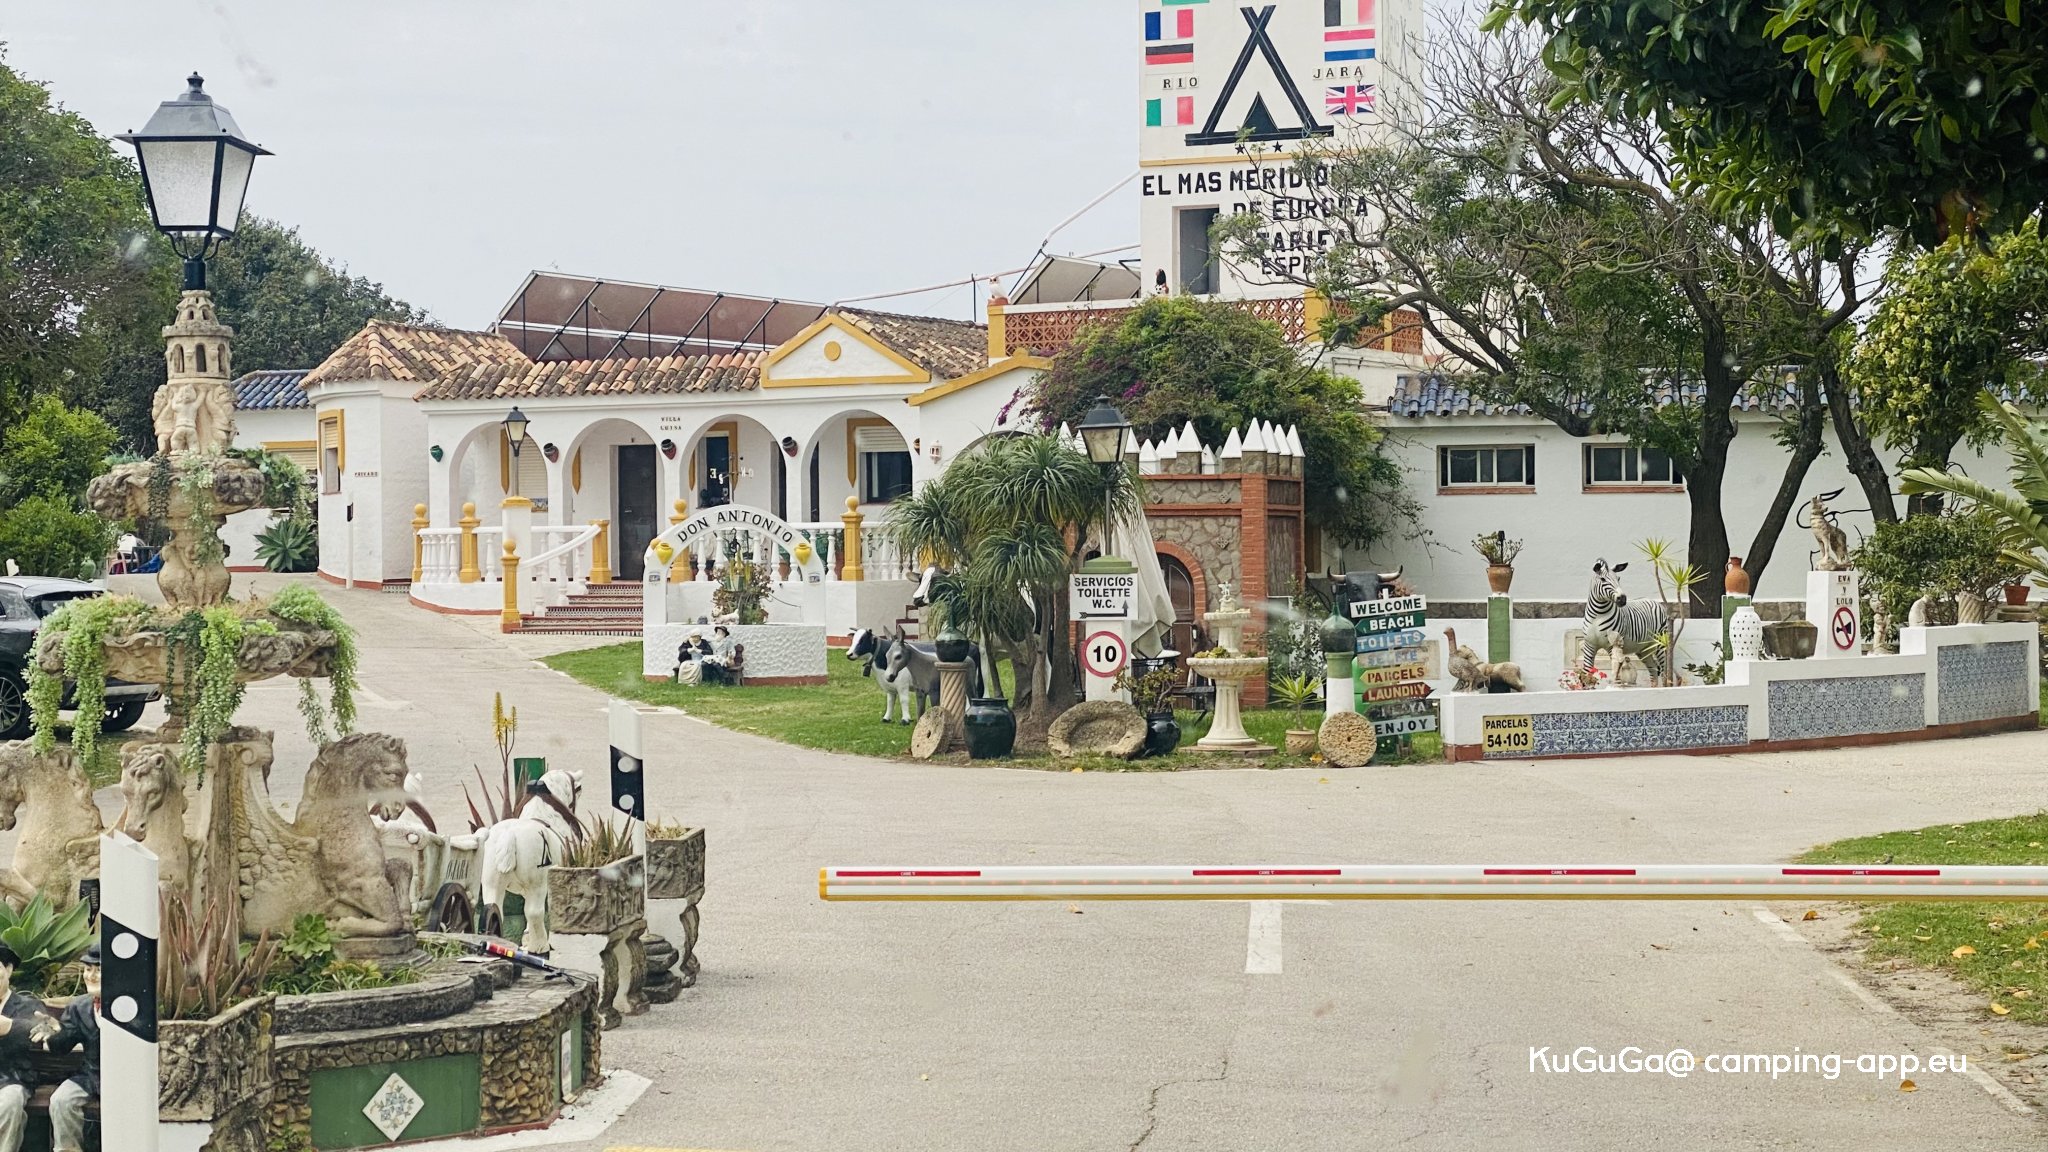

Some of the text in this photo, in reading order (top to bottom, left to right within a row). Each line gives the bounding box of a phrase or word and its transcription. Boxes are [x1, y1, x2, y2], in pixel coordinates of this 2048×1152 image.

[1163, 65, 1363, 88] RIO JARA
[1142, 174, 1171, 196] EL
[1177, 171, 1222, 194] MAS
[677, 509, 793, 543] DON ANTONIO
[1838, 575, 1851, 583] EVA
[1077, 588, 1131, 598] TOILETTE
[1092, 599, 1116, 609] W.C.
[1355, 597, 1422, 616] WELCOME
[1369, 615, 1415, 631] BEACH
[1357, 632, 1421, 650] TOILETS
[1093, 645, 1117, 663] 10
[1367, 667, 1425, 684] PARCELS
[1374, 719, 1428, 735] ENJOY
[1485, 718, 1529, 730] PARCELAS
